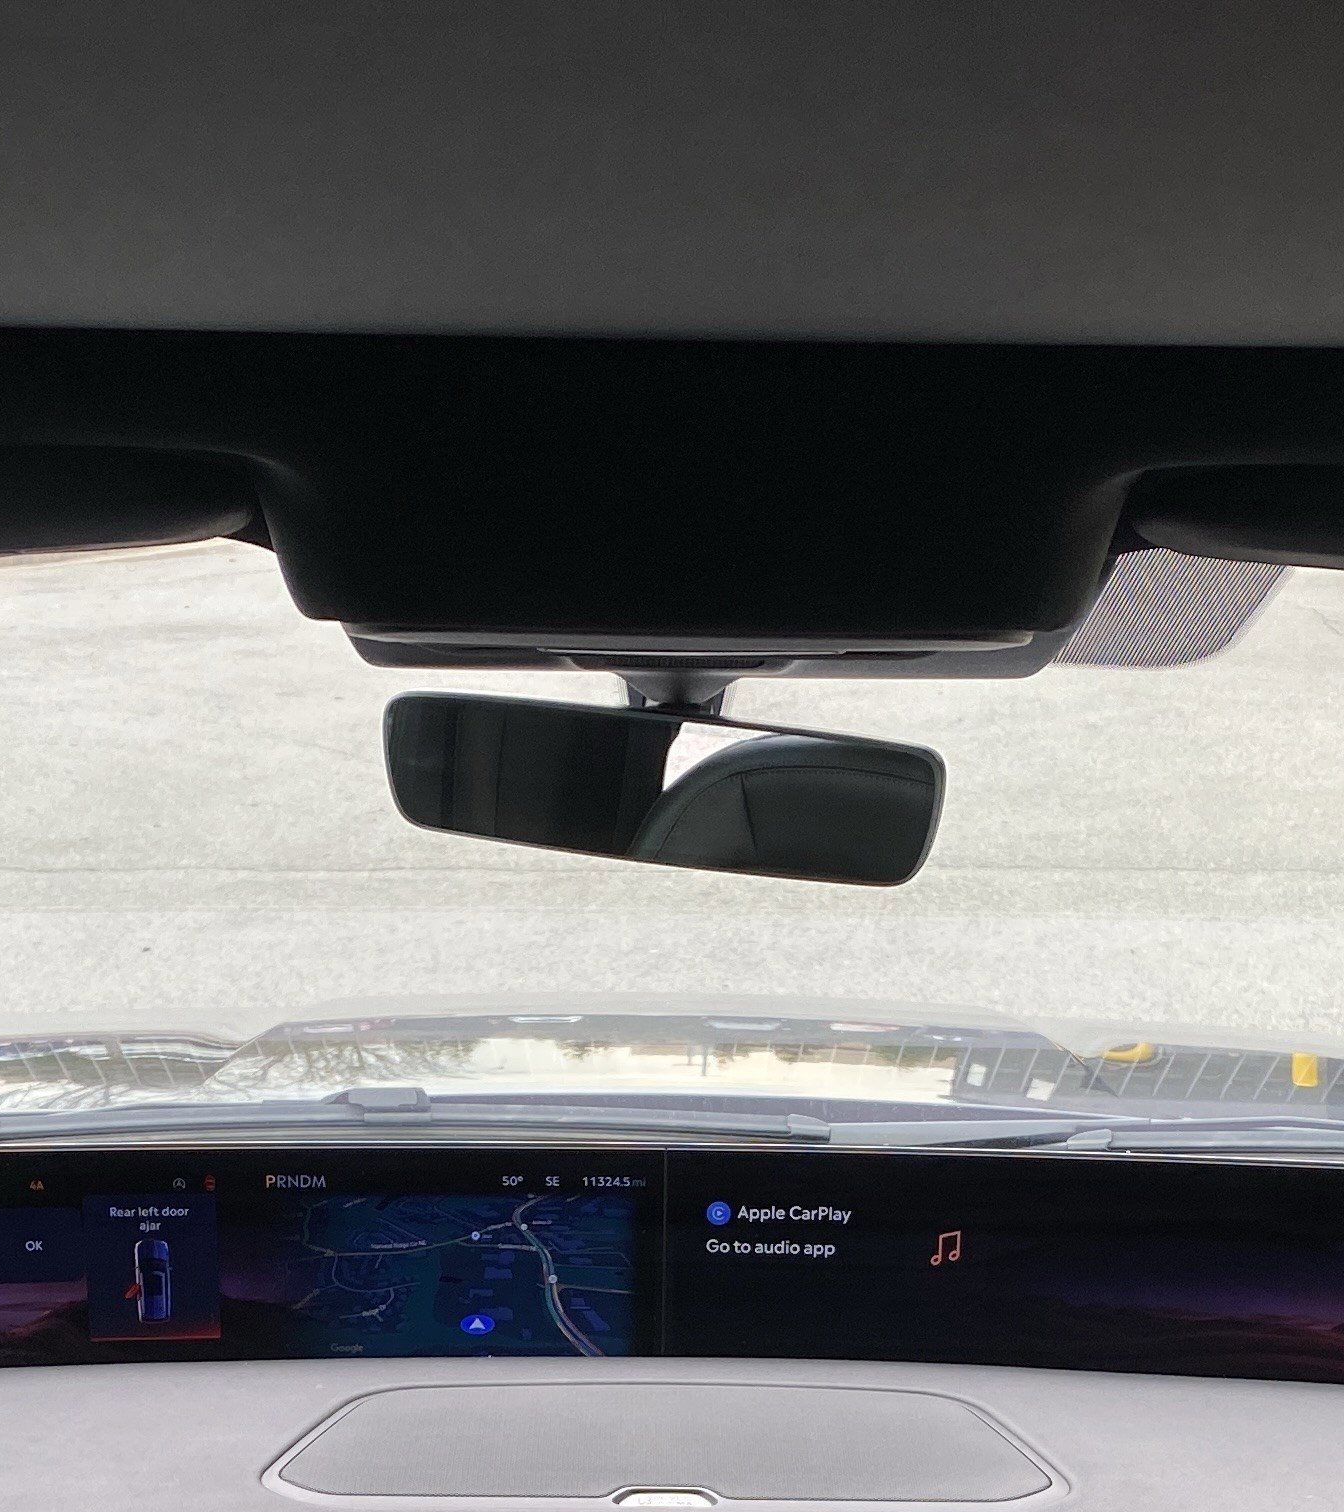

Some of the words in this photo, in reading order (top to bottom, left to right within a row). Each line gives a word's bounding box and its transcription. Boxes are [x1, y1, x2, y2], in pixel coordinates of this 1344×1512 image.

[265, 1174, 327, 1188] PRNDM
[545, 1175, 560, 1187] SE
[582, 1175, 631, 1187] 11324.5
[109, 1206, 136, 1217] Rear
[138, 1206, 159, 1217] left
[161, 1206, 189, 1217] door
[737, 1205, 786, 1224] Apple
[789, 1205, 852, 1225] CarPlay
[139, 1221, 161, 1233] ajar
[25, 1240, 43, 1251] OK
[706, 1239, 730, 1254] Go
[733, 1240, 752, 1254] to
[754, 1239, 801, 1255] audio
[803, 1243, 836, 1258] app
